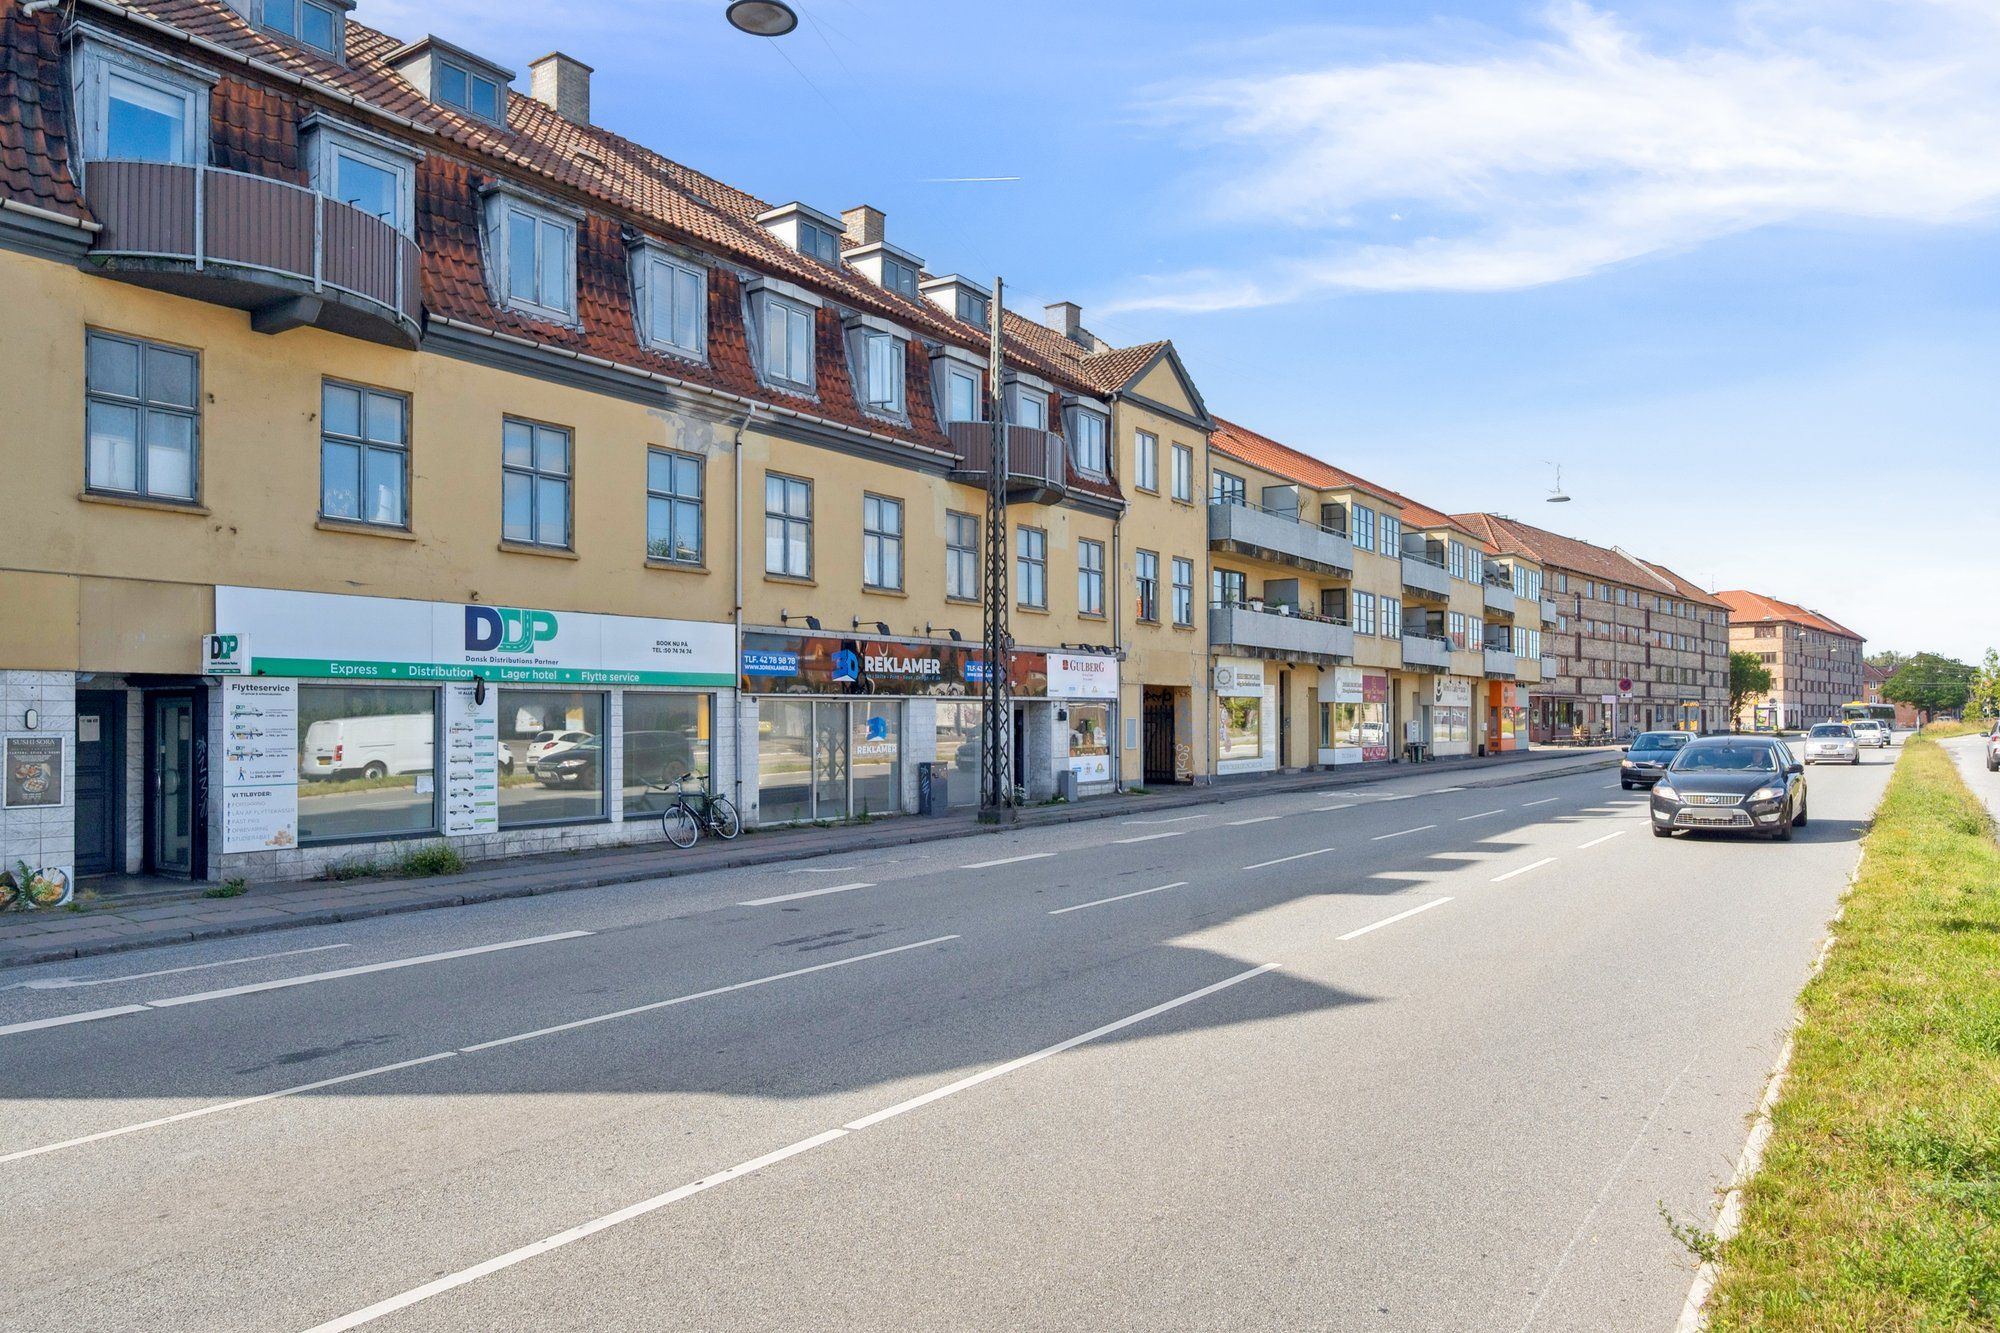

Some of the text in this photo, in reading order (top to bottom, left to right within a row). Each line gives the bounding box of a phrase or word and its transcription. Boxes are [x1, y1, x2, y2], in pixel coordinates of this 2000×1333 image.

[465, 605, 559, 654] DDP
[211, 635, 238, 660] DDP
[465, 655, 559, 666] Dansk Distributions Partner
[744, 655, 759, 663] TLF.
[759, 656, 768, 664] 42
[769, 656, 777, 664] 78
[788, 657, 796, 665] 78
[831, 649, 941, 680] 3D REKLAMER
[330, 663, 640, 682] Express Distribution Lager hotel Flytte service
[231, 683, 290, 692] Flytteservice
[856, 745, 897, 754] REKLAMER
